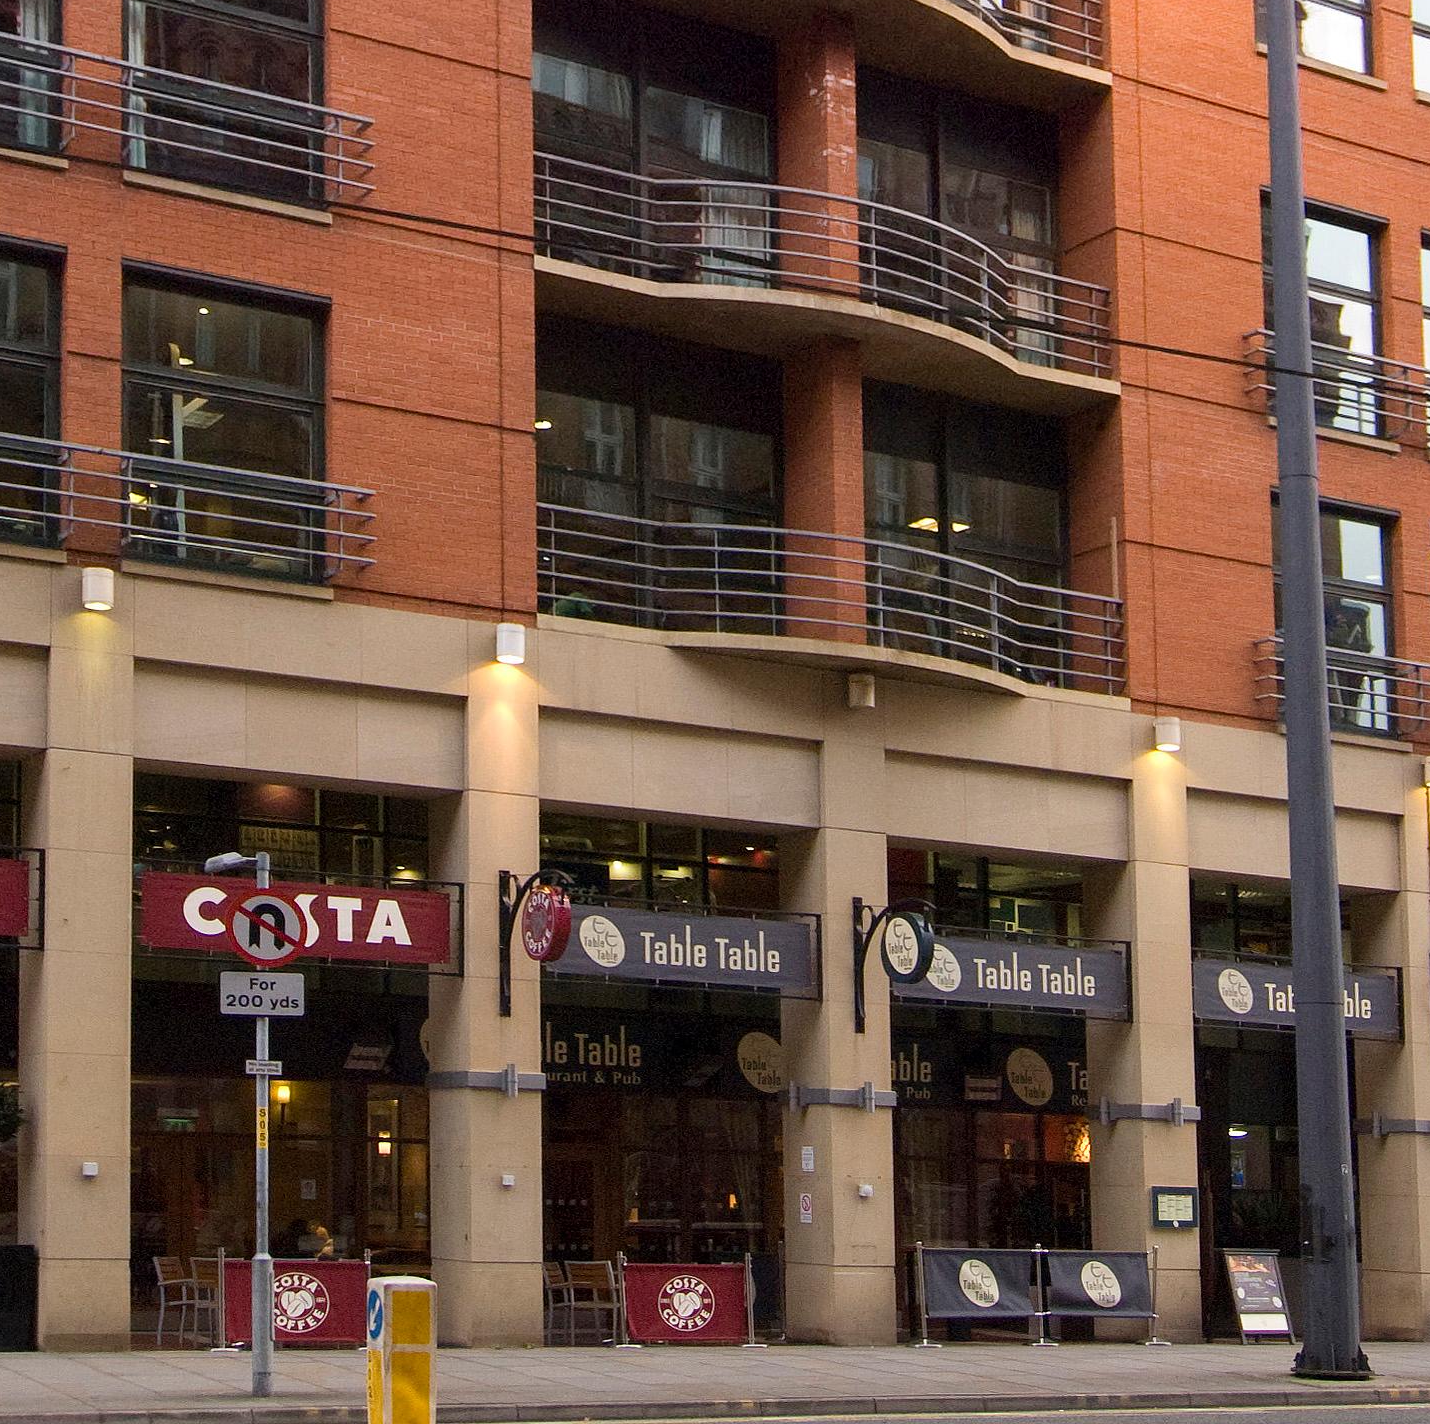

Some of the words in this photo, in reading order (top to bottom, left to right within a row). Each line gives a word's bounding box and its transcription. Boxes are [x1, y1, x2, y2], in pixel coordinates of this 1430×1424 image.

[182, 885, 413, 948] CSTA
[597, 947, 619, 961] Table
[639, 924, 707, 968] Table
[714, 929, 781, 973] Table
[972, 951, 1032, 992] Table
[1038, 957, 1097, 997] Table
[249, 977, 277, 992] For
[225, 994, 264, 1009] 200
[270, 992, 300, 1012] yds
[574, 1024, 642, 1068] Table
[593, 1071, 605, 1084] &
[612, 1071, 641, 1086] Pub
[906, 1086, 932, 1100] Pub
[273, 1275, 319, 1294] COSTA
[666, 1278, 705, 1295] COSTA
[963, 1278, 983, 1290] Table
[975, 1289, 996, 1302] Table
[663, 1308, 711, 1330] COFFEE
